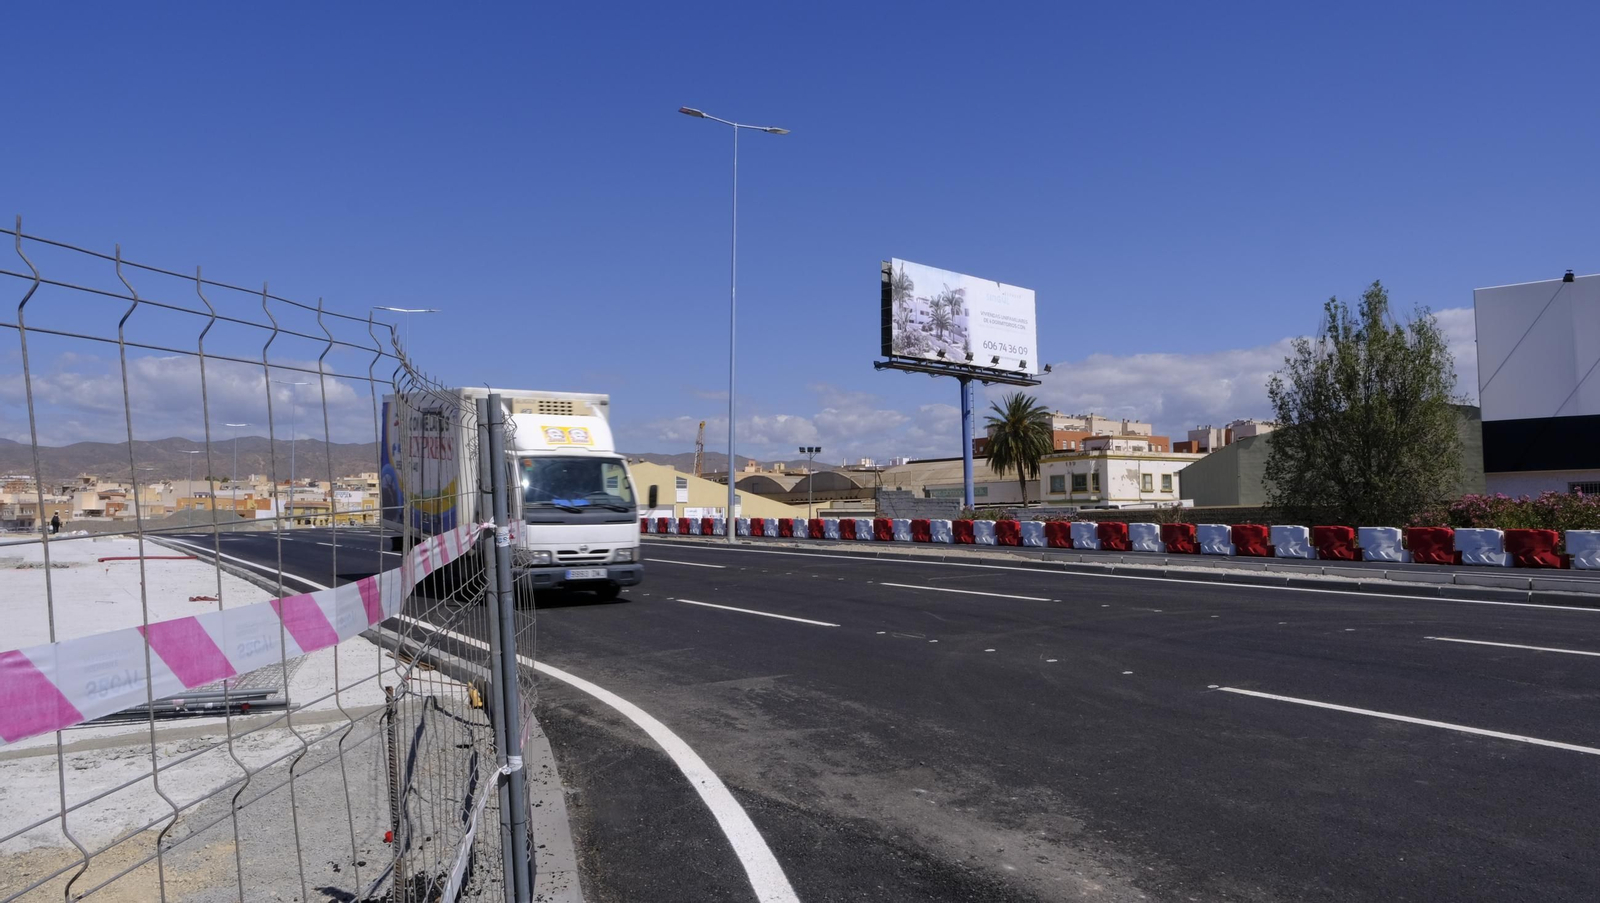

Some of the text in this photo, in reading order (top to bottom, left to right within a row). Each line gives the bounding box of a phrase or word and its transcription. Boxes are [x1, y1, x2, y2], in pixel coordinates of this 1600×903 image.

[983, 340, 1028, 356] 606 74 36 09
